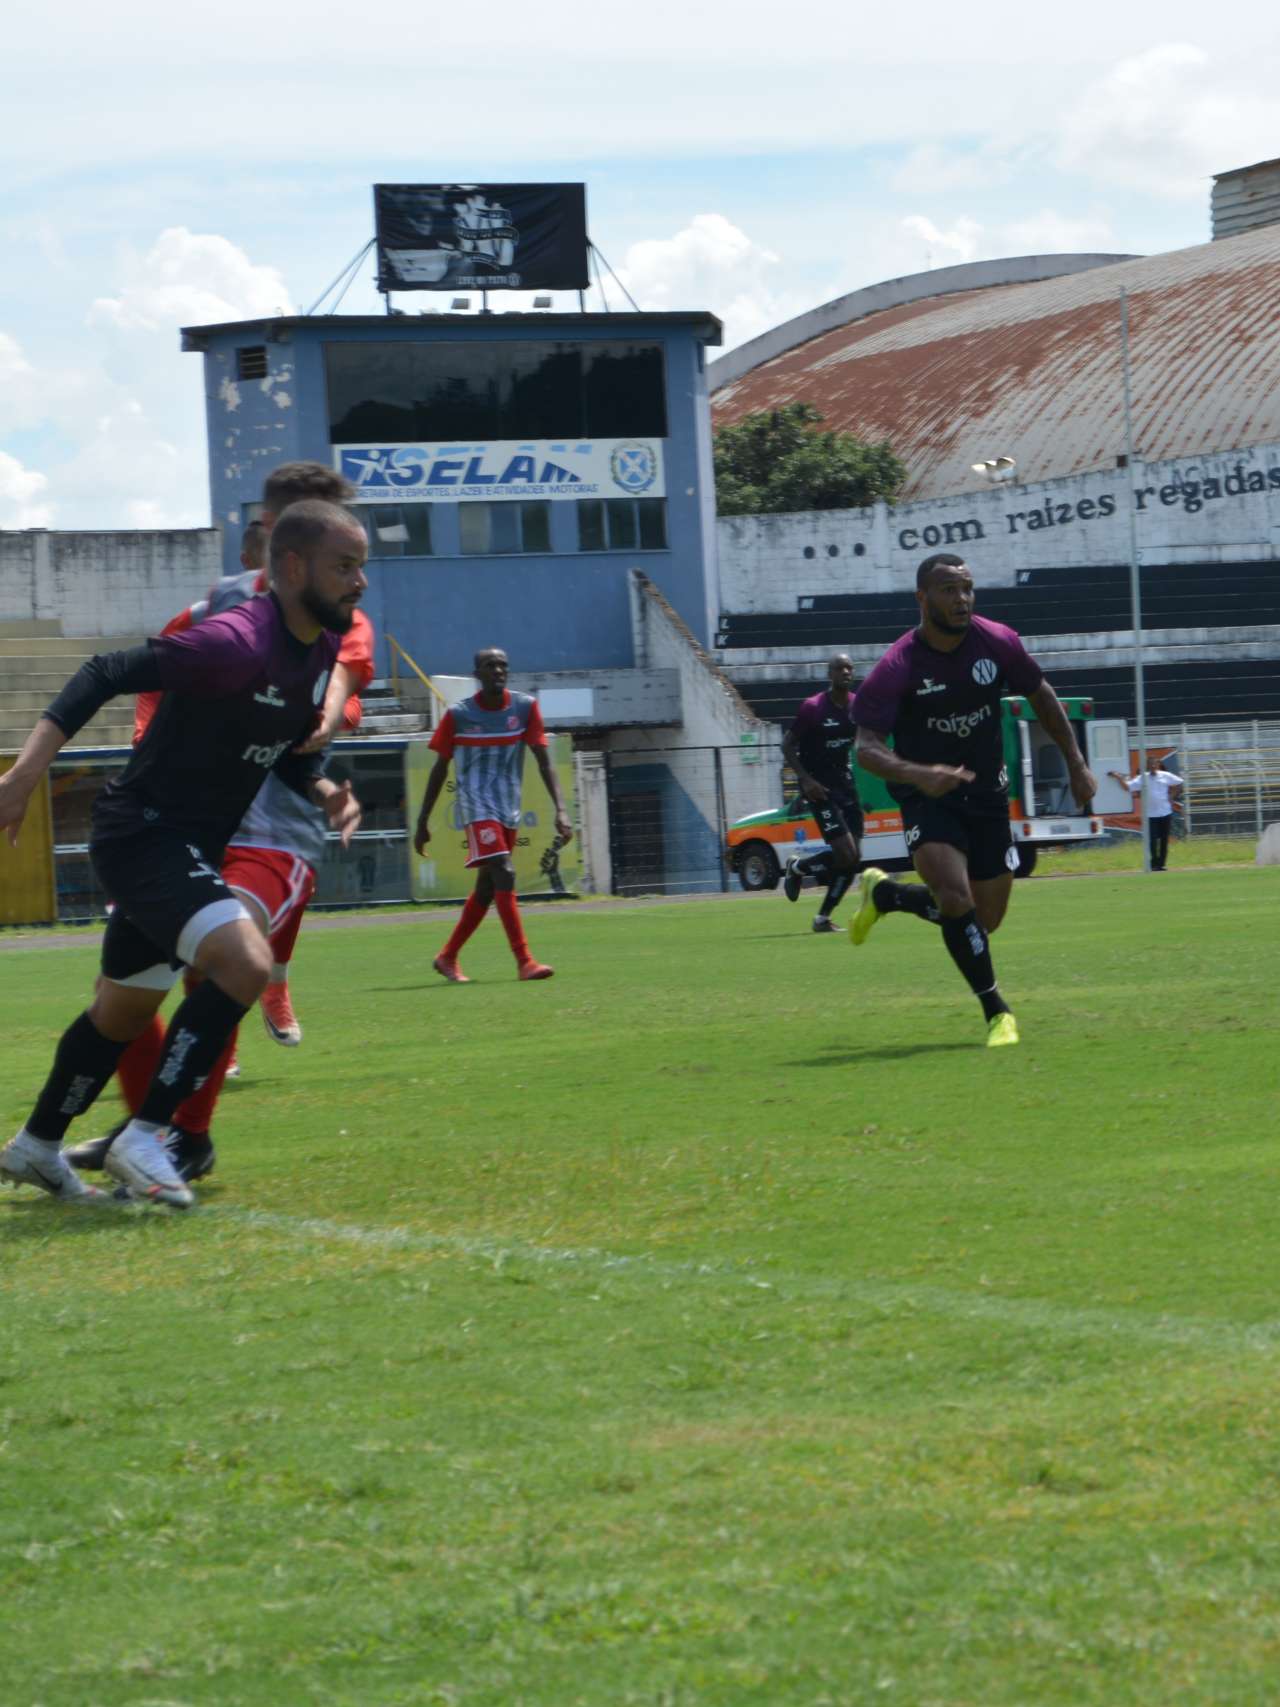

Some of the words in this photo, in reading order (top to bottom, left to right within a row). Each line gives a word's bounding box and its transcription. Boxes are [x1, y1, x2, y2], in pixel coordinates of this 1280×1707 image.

[387, 444, 592, 486] SELAM
[549, 482, 599, 494] MOTORAS
[899, 518, 985, 551] com
[1006, 493, 1116, 534] raízes
[905, 825, 921, 846] 06
